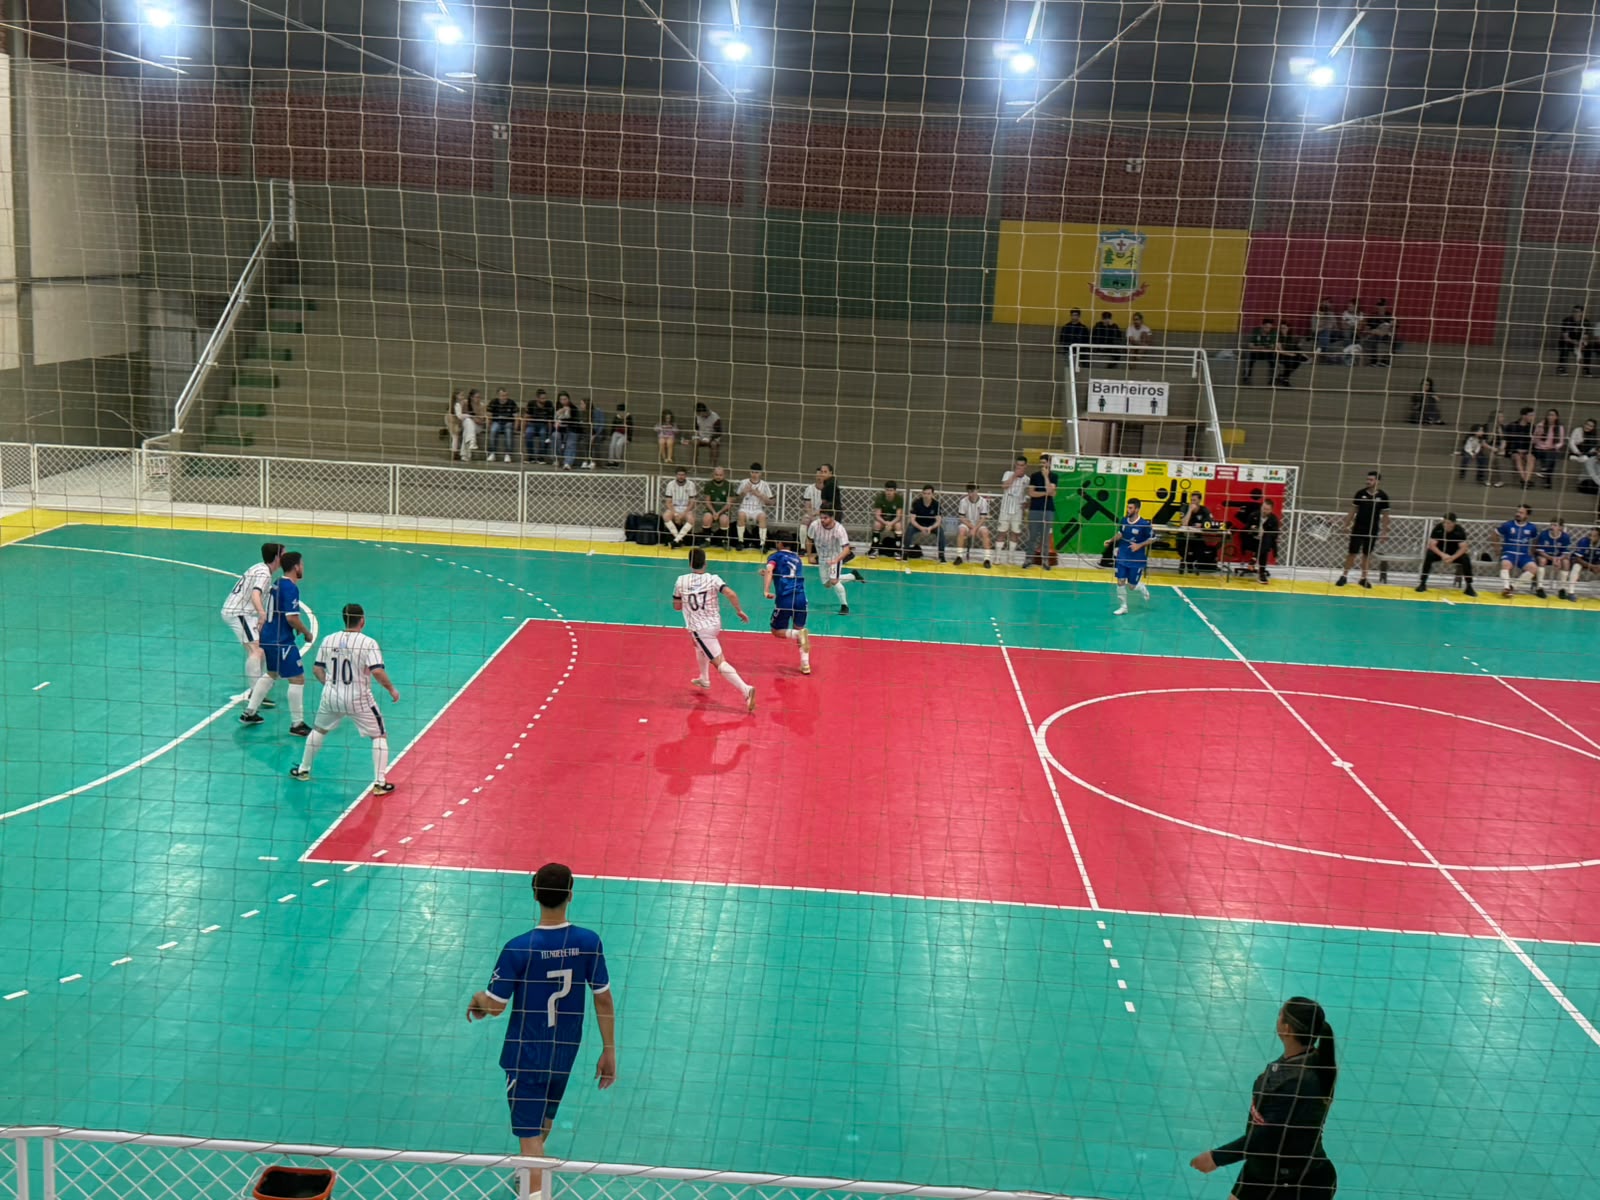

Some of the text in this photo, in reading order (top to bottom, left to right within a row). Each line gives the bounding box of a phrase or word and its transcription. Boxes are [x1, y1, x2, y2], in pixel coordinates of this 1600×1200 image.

[1092, 382, 1165, 397] Banheiros
[689, 591, 708, 611] 07
[331, 657, 353, 685] 10
[546, 969, 573, 1028] 7
